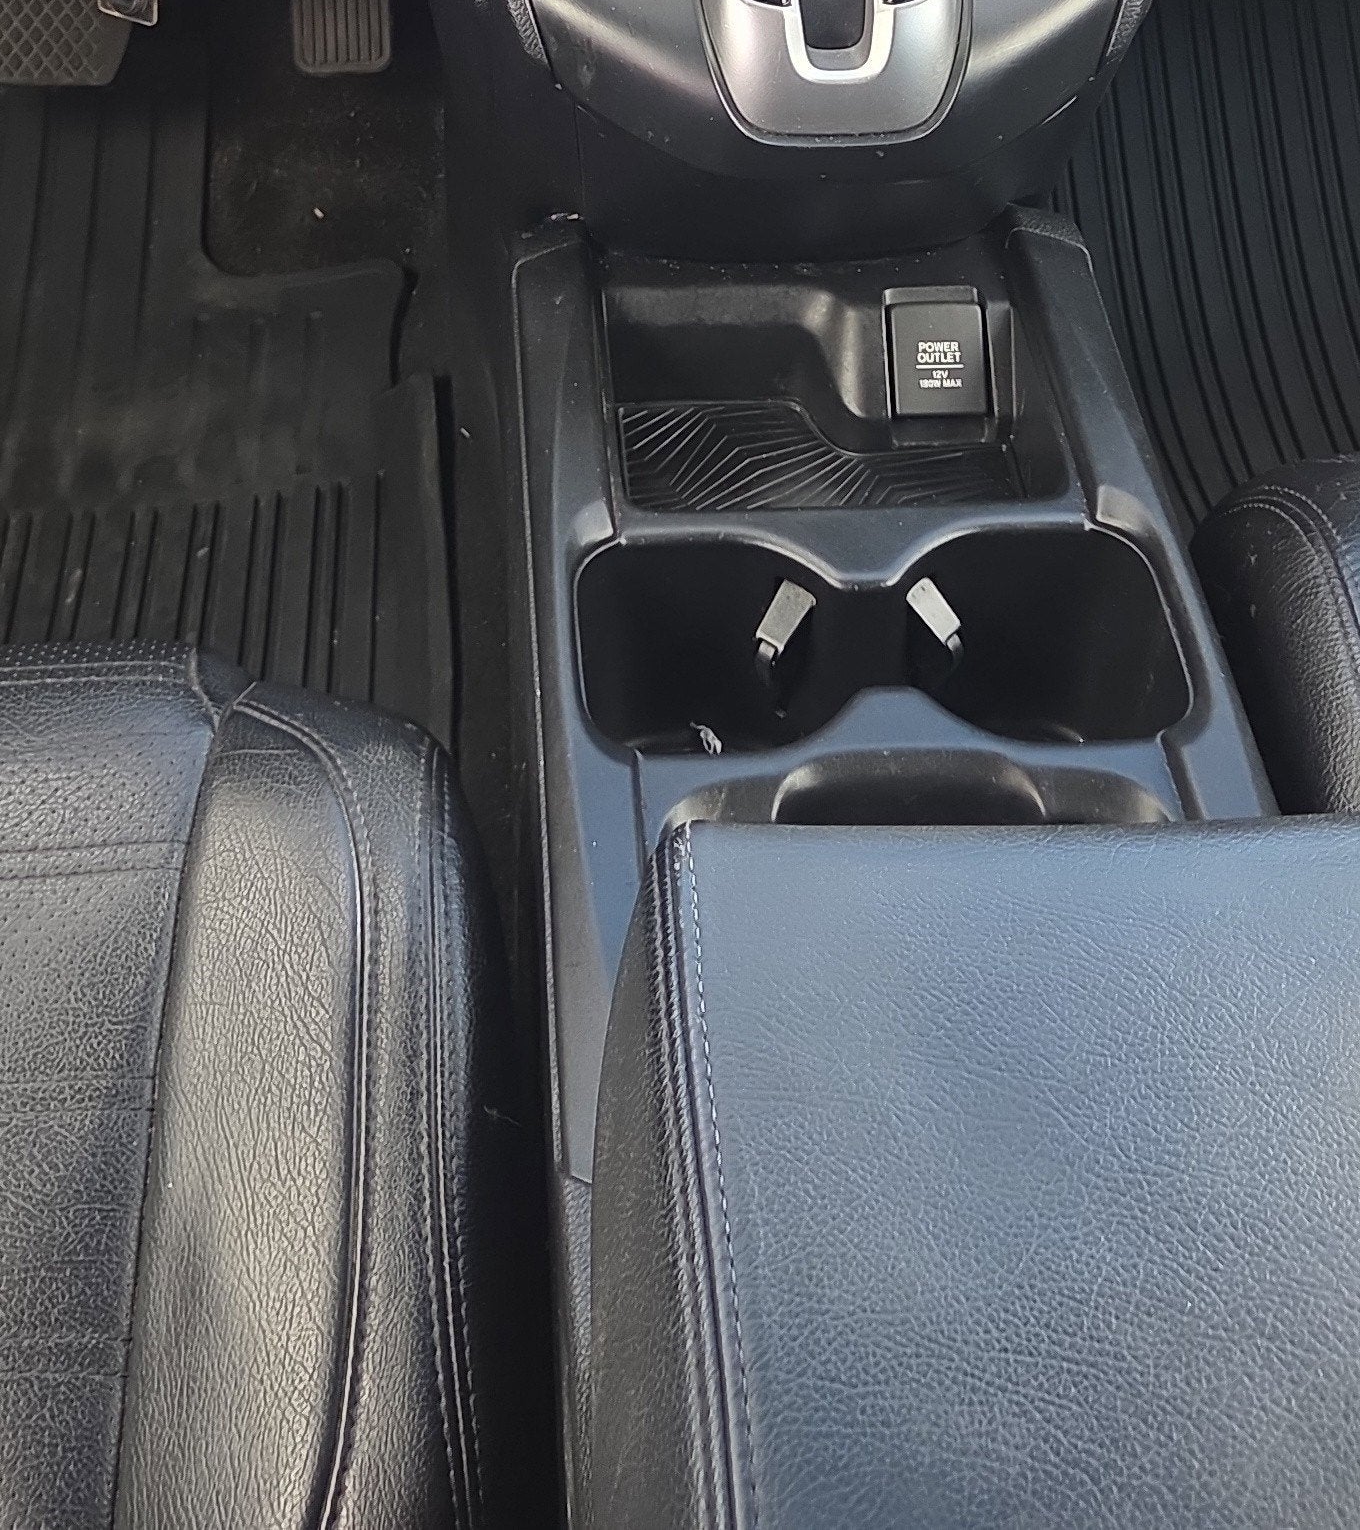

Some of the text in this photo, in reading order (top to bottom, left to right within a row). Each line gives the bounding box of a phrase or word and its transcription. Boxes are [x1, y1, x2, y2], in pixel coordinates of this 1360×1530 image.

[918, 341, 960, 353] POWER
[916, 352, 962, 364] OUTLET
[932, 370, 949, 379] 12V
